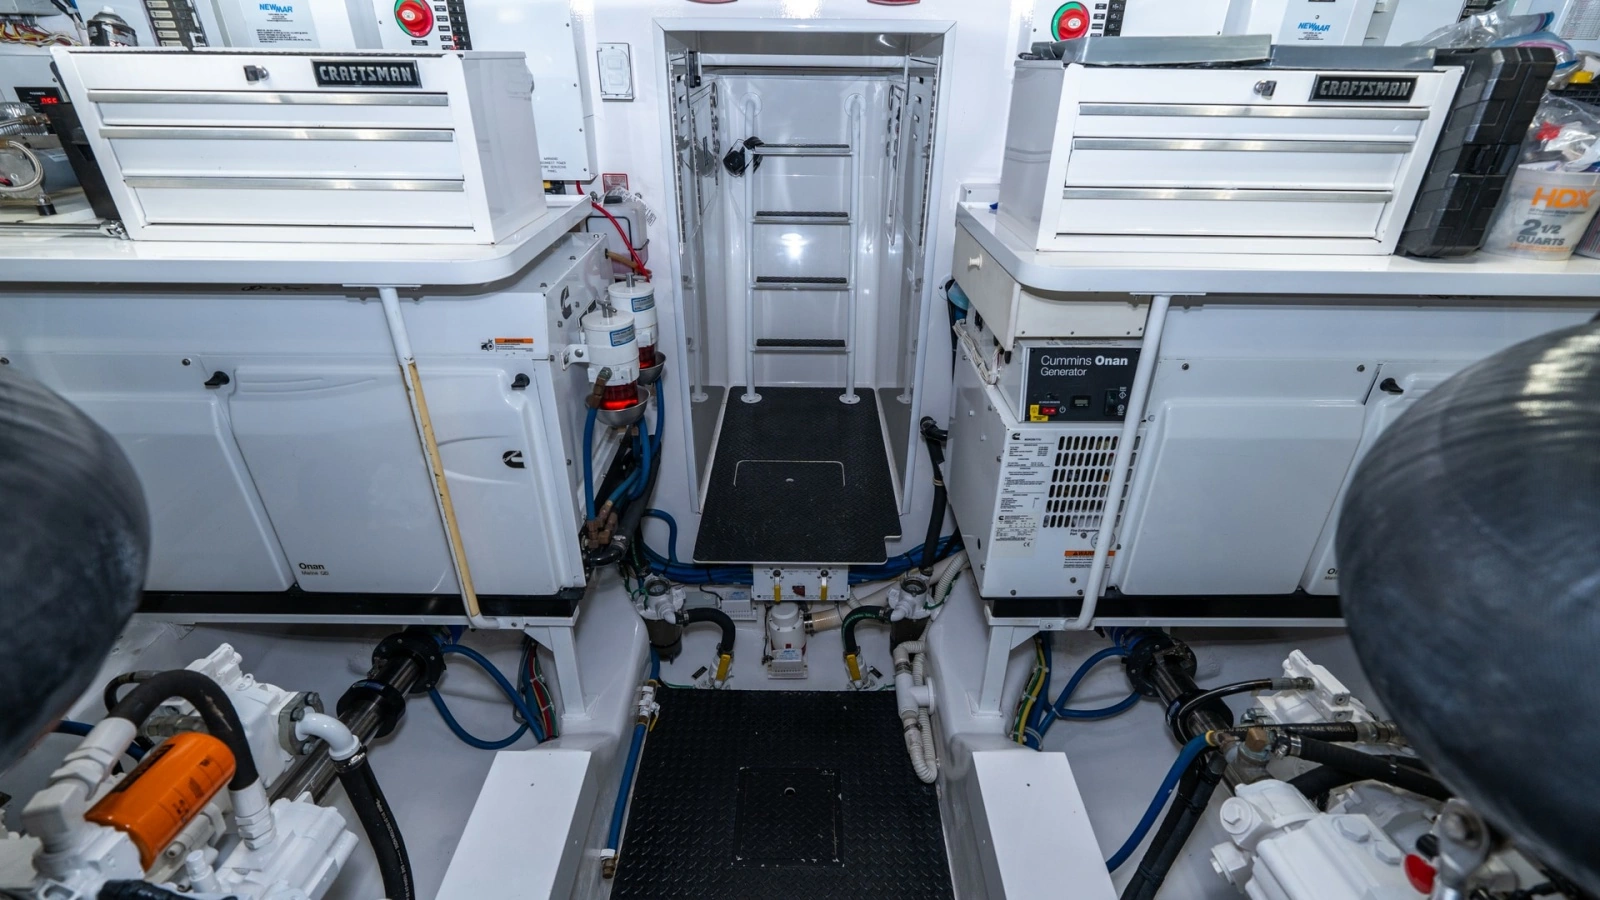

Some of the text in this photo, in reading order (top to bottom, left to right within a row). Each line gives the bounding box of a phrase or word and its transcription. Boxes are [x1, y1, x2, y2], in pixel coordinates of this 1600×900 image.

[259, 4, 293, 12] NEWMAR
[1298, 22, 1330, 31] NEWMAR
[319, 66, 413, 82] CRAFTSMAN
[1320, 80, 1411, 96] CRAFTSMAN
[1531, 186, 1597, 209] HDX
[1519, 219, 1561, 236] 2 1/2
[1516, 235, 1565, 246] QUARTS
[1041, 355, 1128, 366] Cummins Onan
[1041, 367, 1087, 376] Generator
